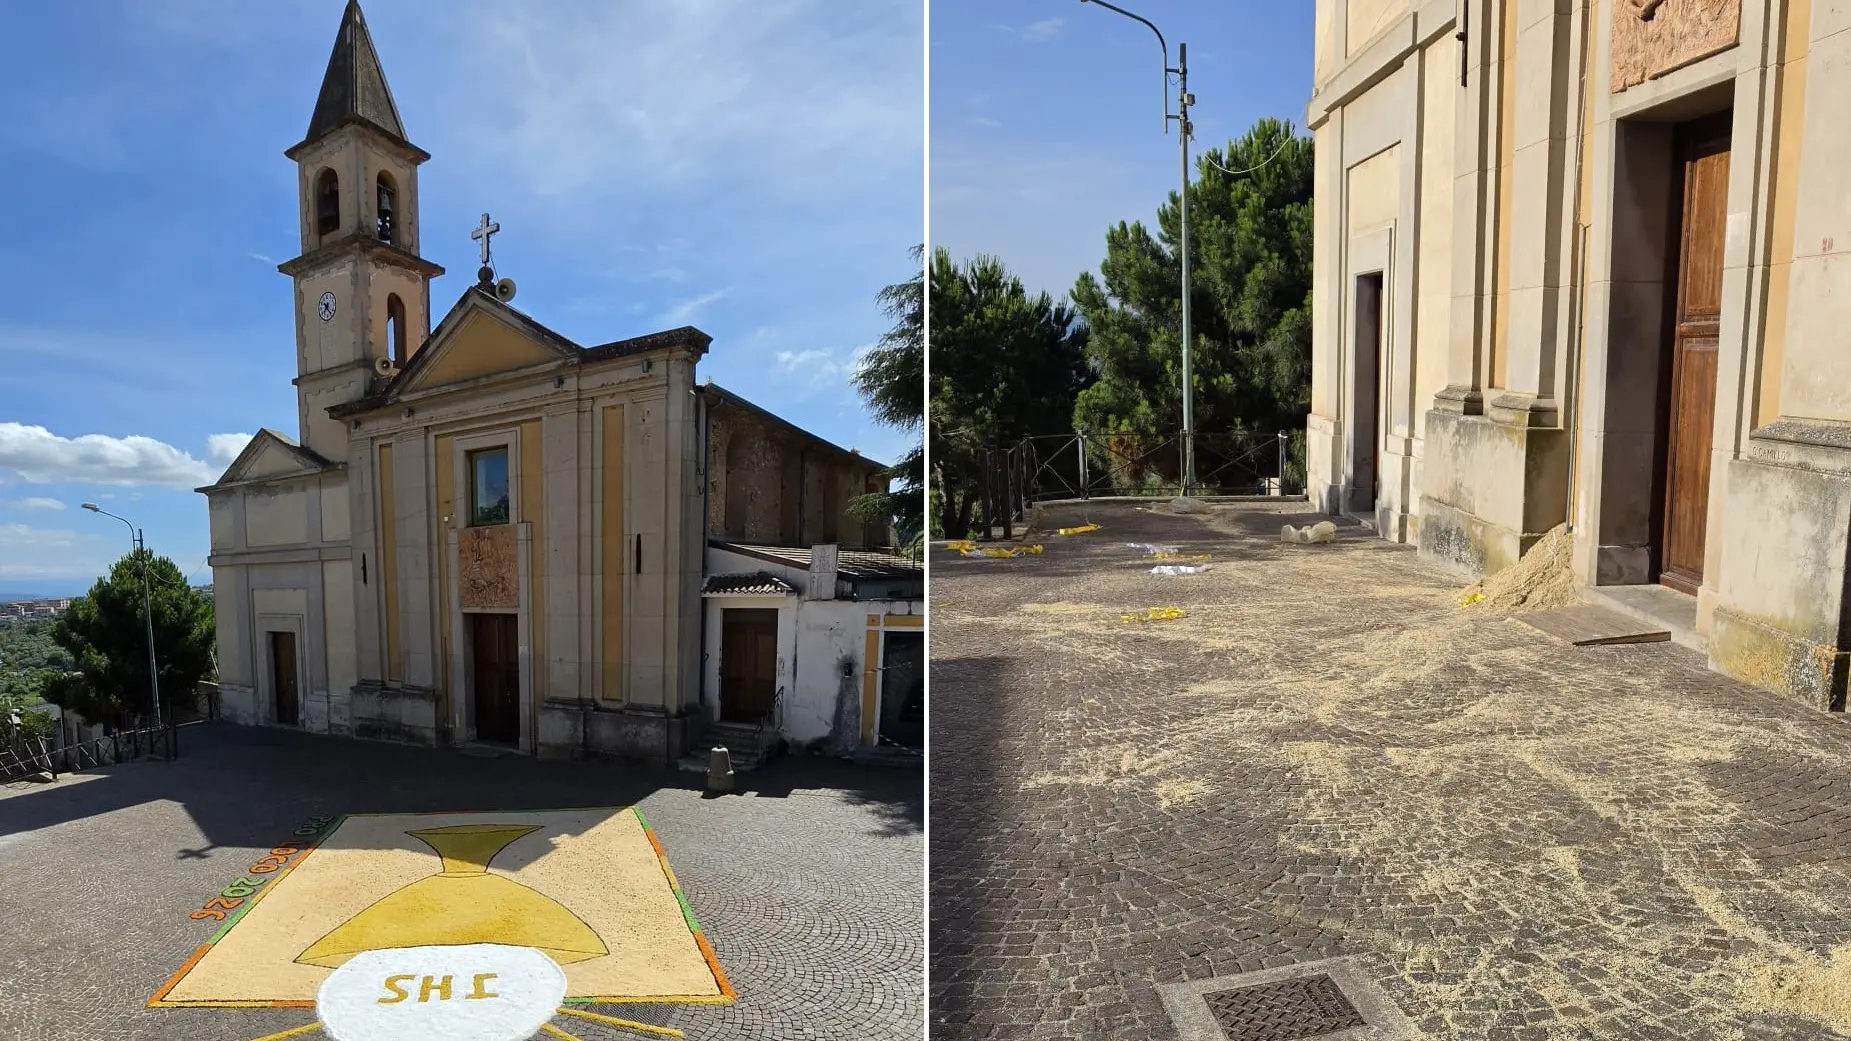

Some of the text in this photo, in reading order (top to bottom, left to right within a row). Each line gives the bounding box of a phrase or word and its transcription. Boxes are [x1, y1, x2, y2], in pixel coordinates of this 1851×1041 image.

[190, 813, 335, 921] PRO LOCO 2025
